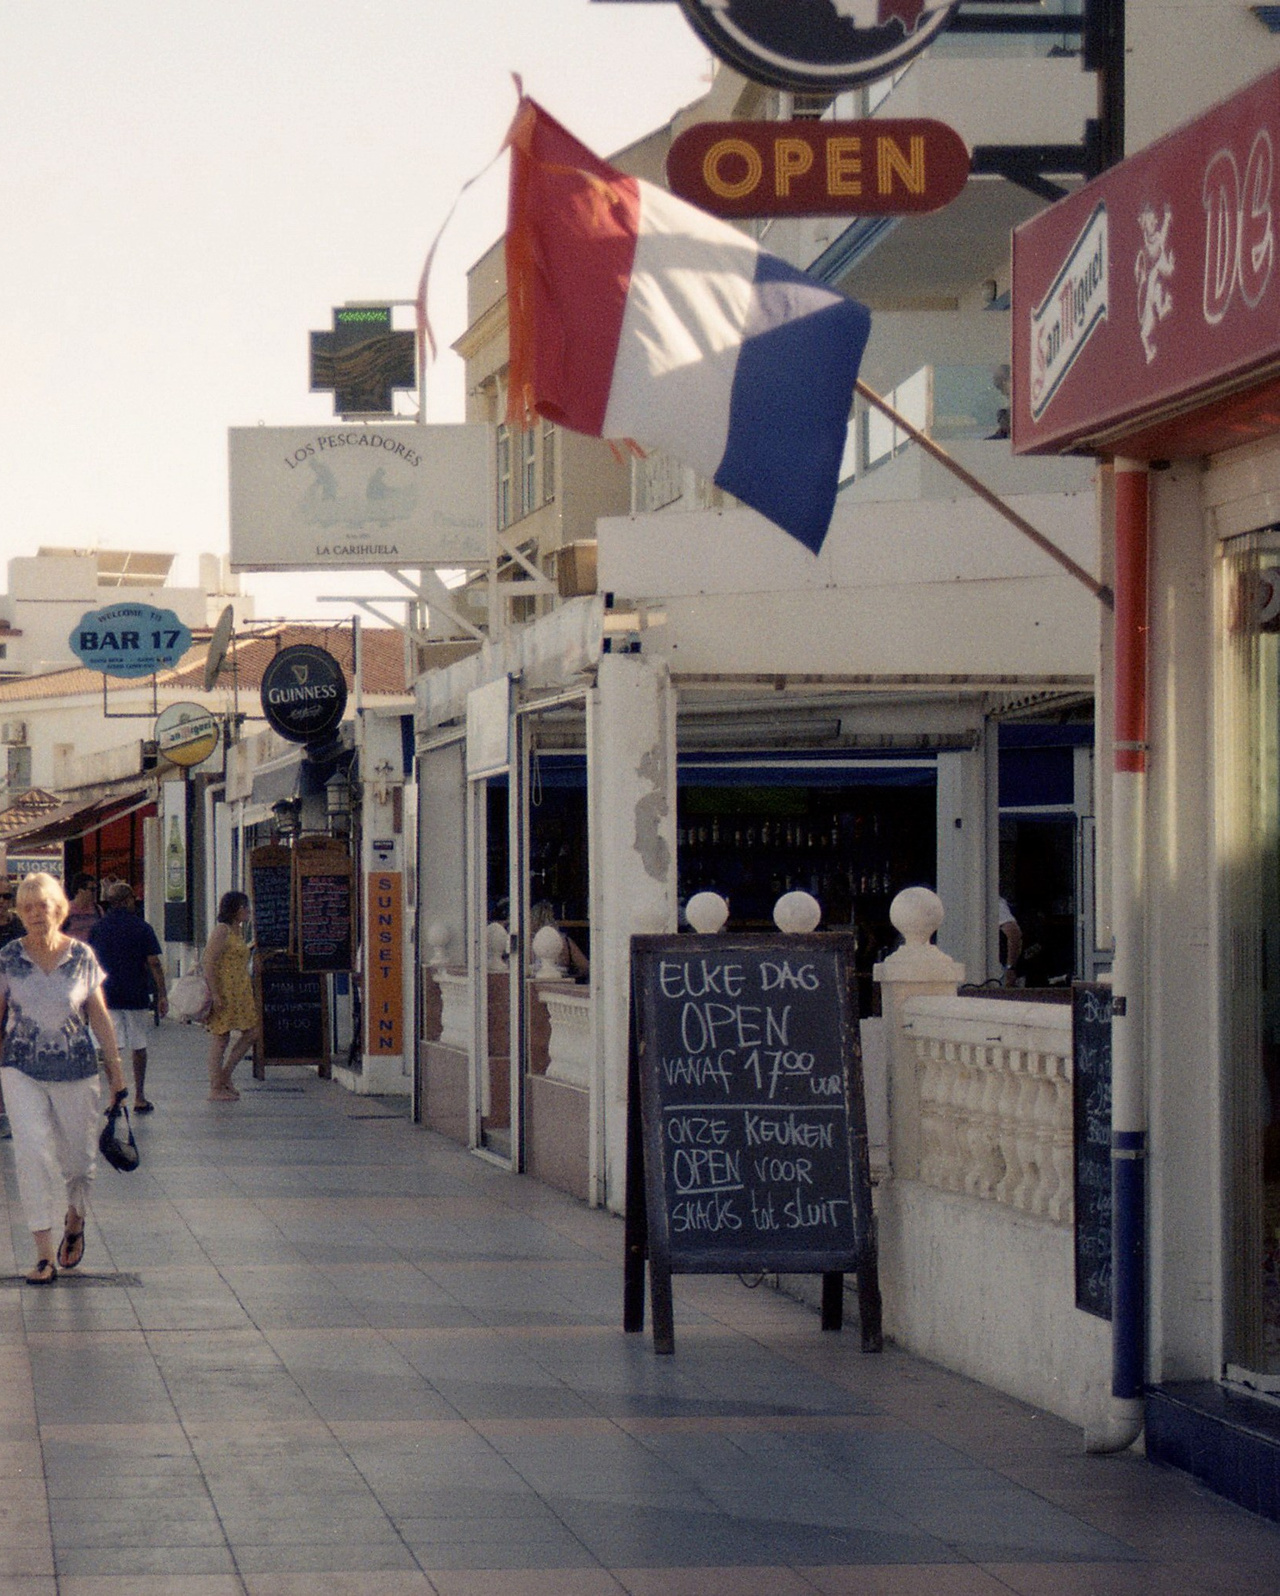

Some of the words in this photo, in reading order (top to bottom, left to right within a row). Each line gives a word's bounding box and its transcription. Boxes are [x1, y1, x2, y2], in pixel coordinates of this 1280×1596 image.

[702, 136, 926, 199] OPEN
[1033, 318, 1061, 401] San
[1058, 232, 1103, 343] Miguel
[284, 443, 316, 470] LOS
[317, 433, 423, 468] PESCADORES
[316, 545, 330, 556] LA
[333, 544, 399, 555] CARIHUELA
[80, 631, 140, 651] BAR
[151, 630, 181, 650] 17
[270, 683, 338, 705] GUINNESS
[379, 878, 393, 979] SUNSET
[660, 960, 746, 999] ELKE
[760, 961, 820, 991] DAG
[379, 1002, 394, 1049] INN
[682, 1002, 792, 1054] OPEN
[668, 1116, 731, 1144] ONZE
[745, 1111, 834, 1149] KEUKEN
[674, 1150, 741, 1190] OPEN
[754, 1157, 813, 1185] VOOR
